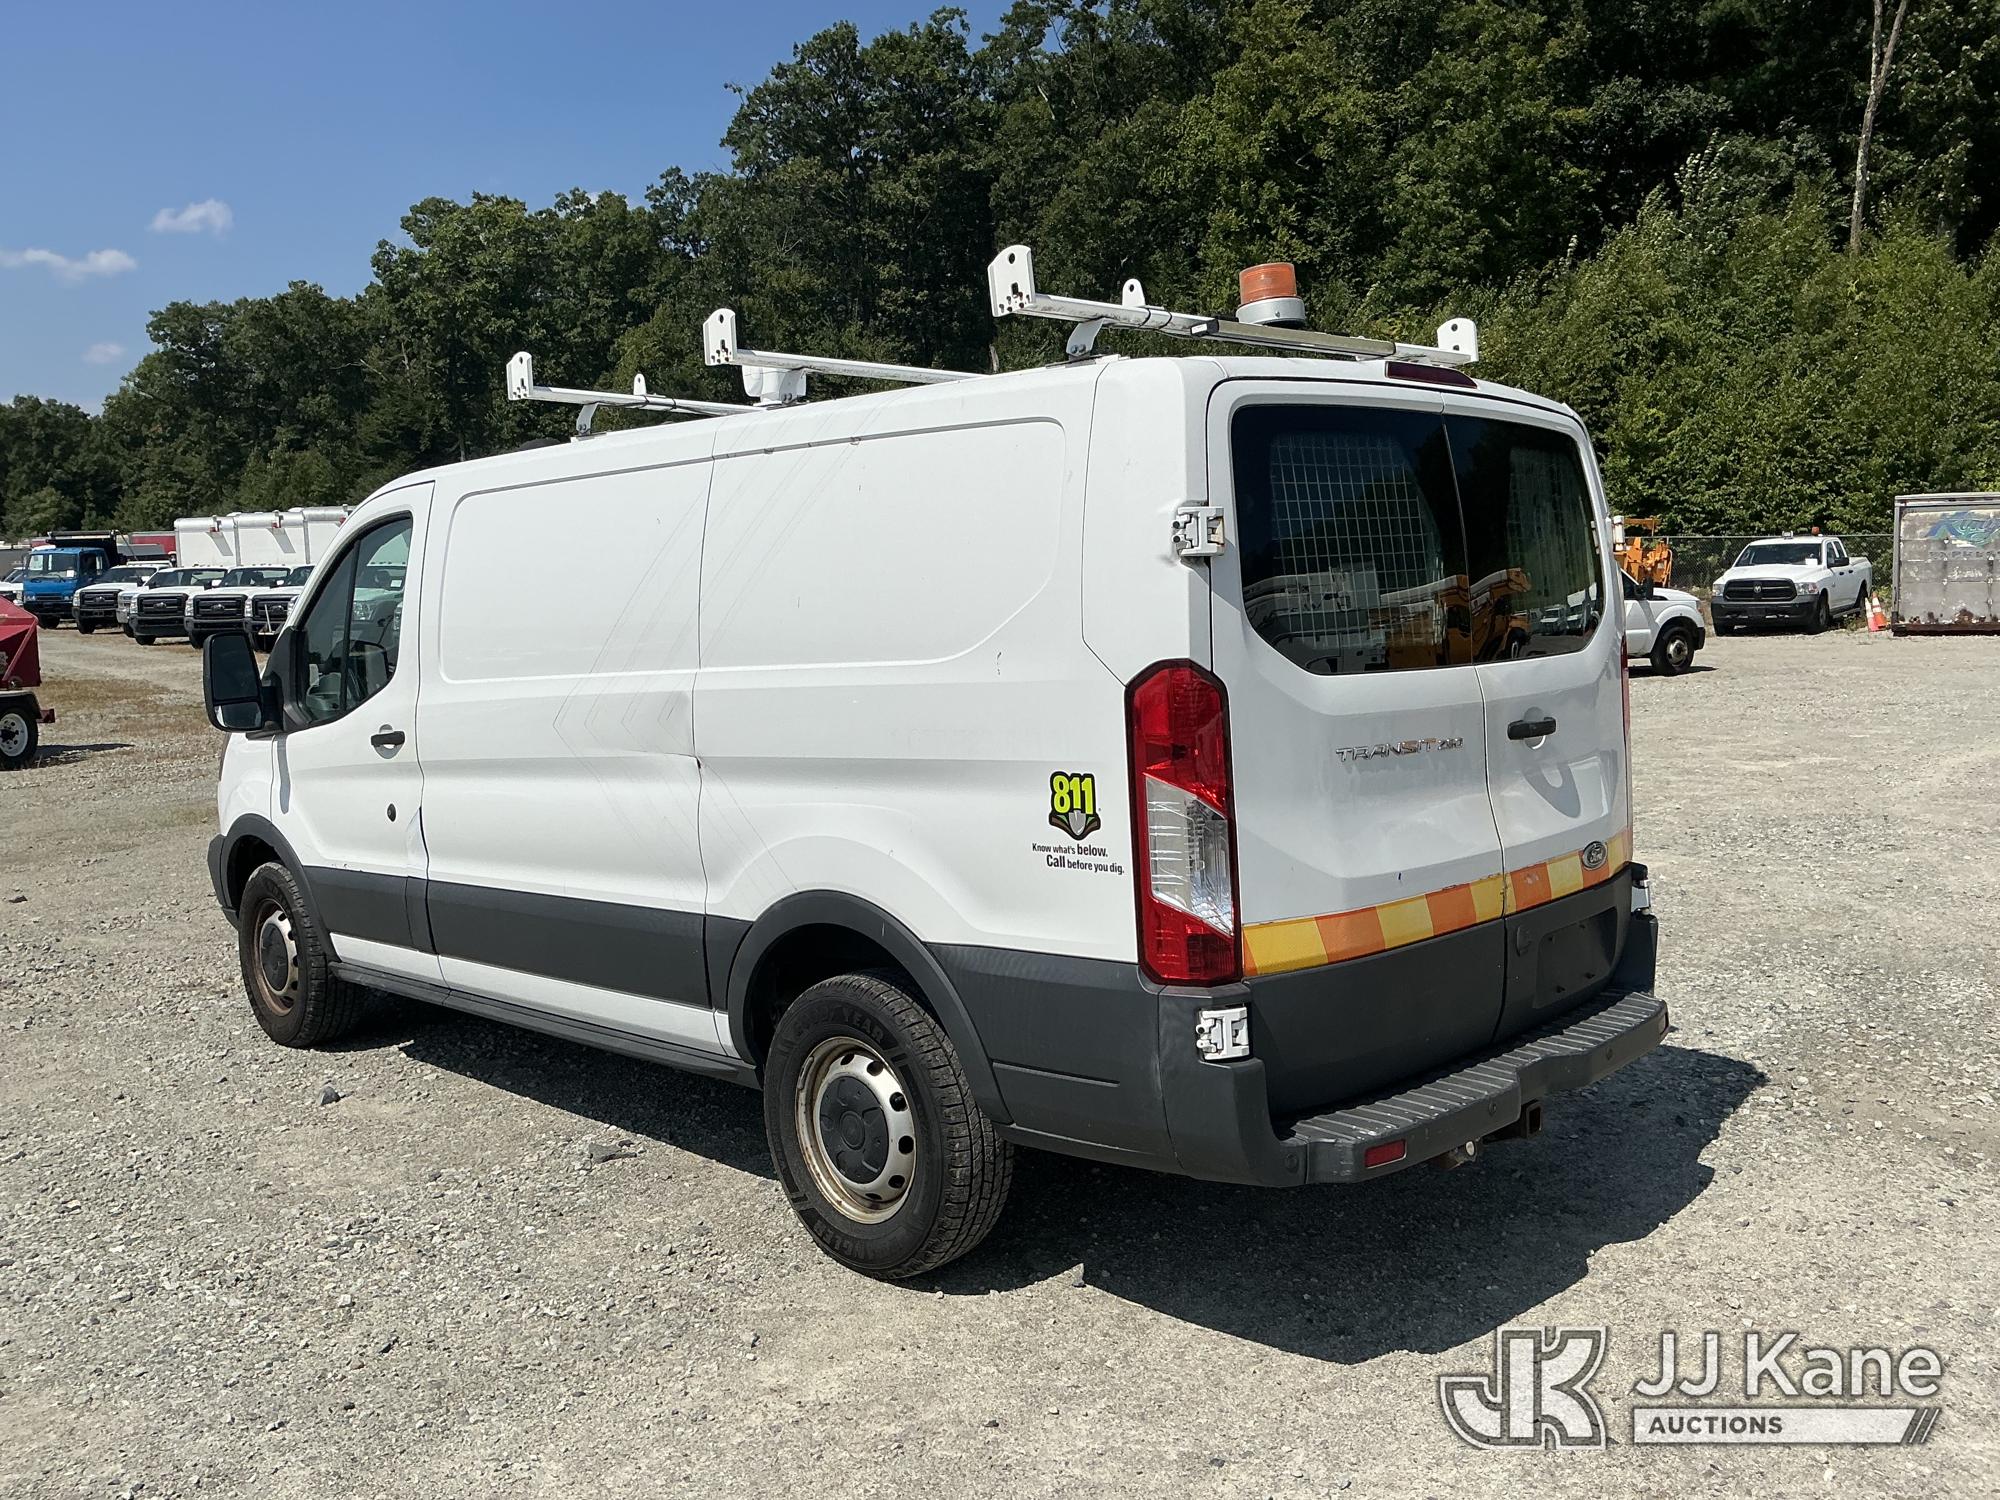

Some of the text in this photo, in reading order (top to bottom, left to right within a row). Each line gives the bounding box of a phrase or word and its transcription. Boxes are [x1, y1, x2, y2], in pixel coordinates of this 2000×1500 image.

[1336, 738, 1437, 762] TRANSIT
[1051, 773, 1096, 815] 811
[1032, 843, 1108, 857] Know what's below.
[1046, 854, 1125, 875] Call before you dig.
